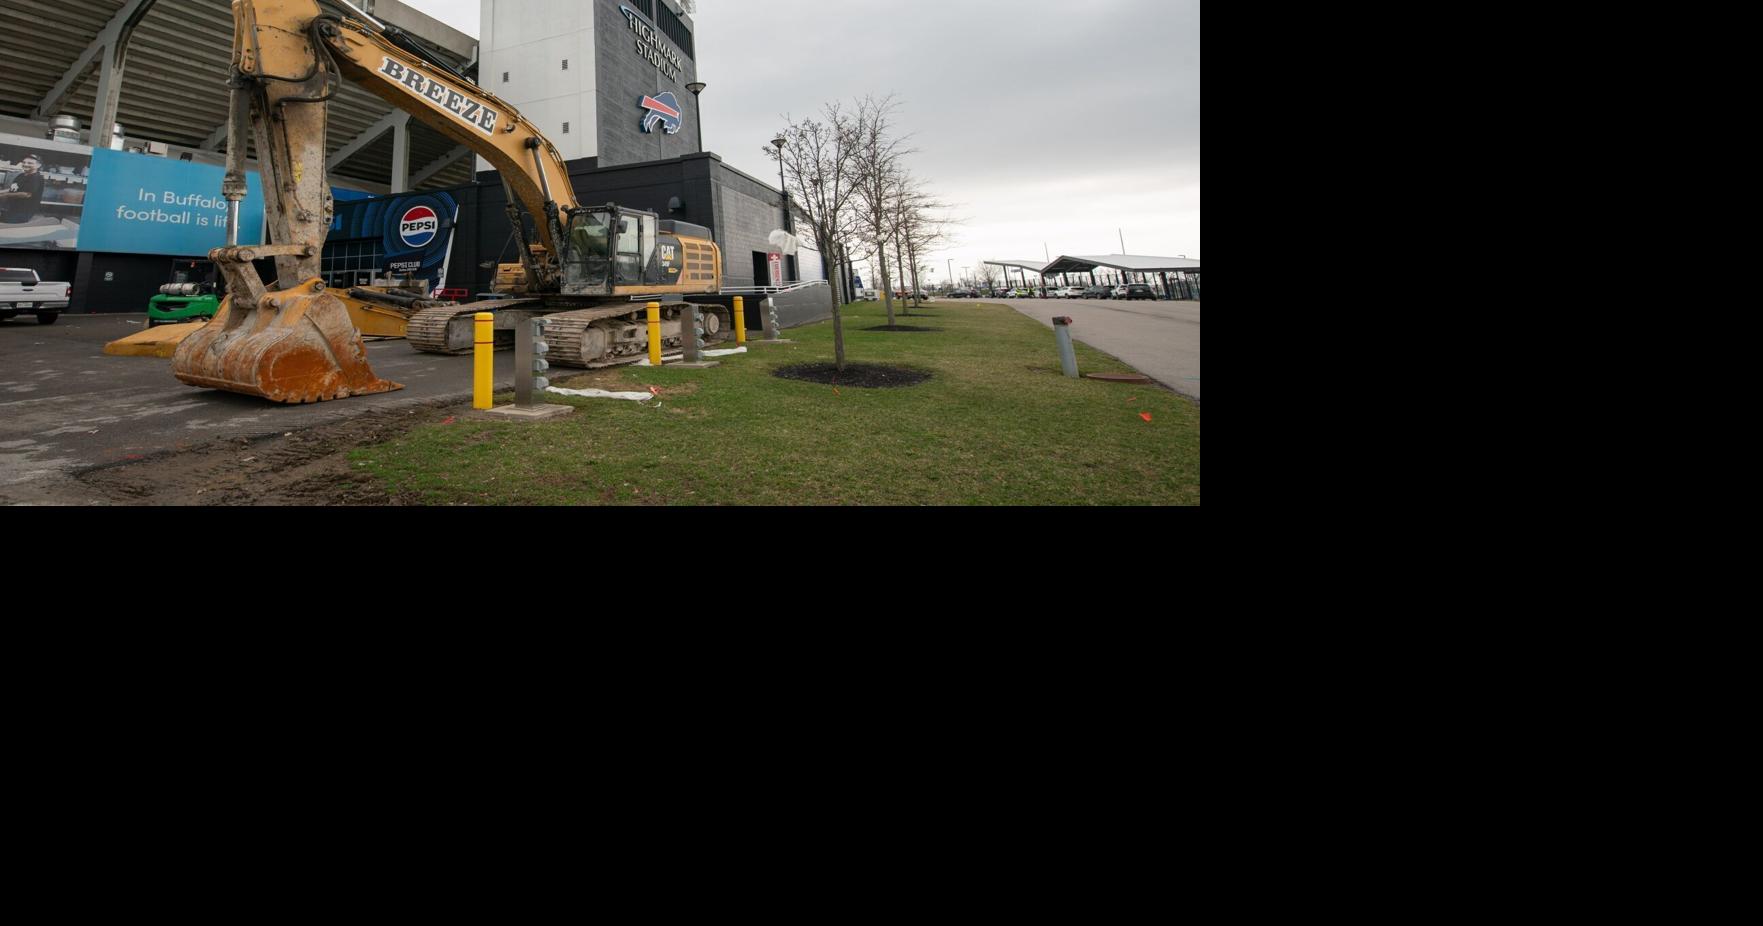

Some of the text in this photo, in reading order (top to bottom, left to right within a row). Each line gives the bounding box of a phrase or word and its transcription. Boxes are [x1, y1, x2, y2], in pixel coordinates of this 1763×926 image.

[628, 12, 682, 72] HIGHMARK
[636, 39, 677, 83] STADIUM
[380, 57, 497, 133] BREEZE
[138, 188, 156, 202] In
[116, 205, 241, 229] football is lif.
[402, 220, 436, 232] PEPSI
[661, 245, 675, 260] CAT
